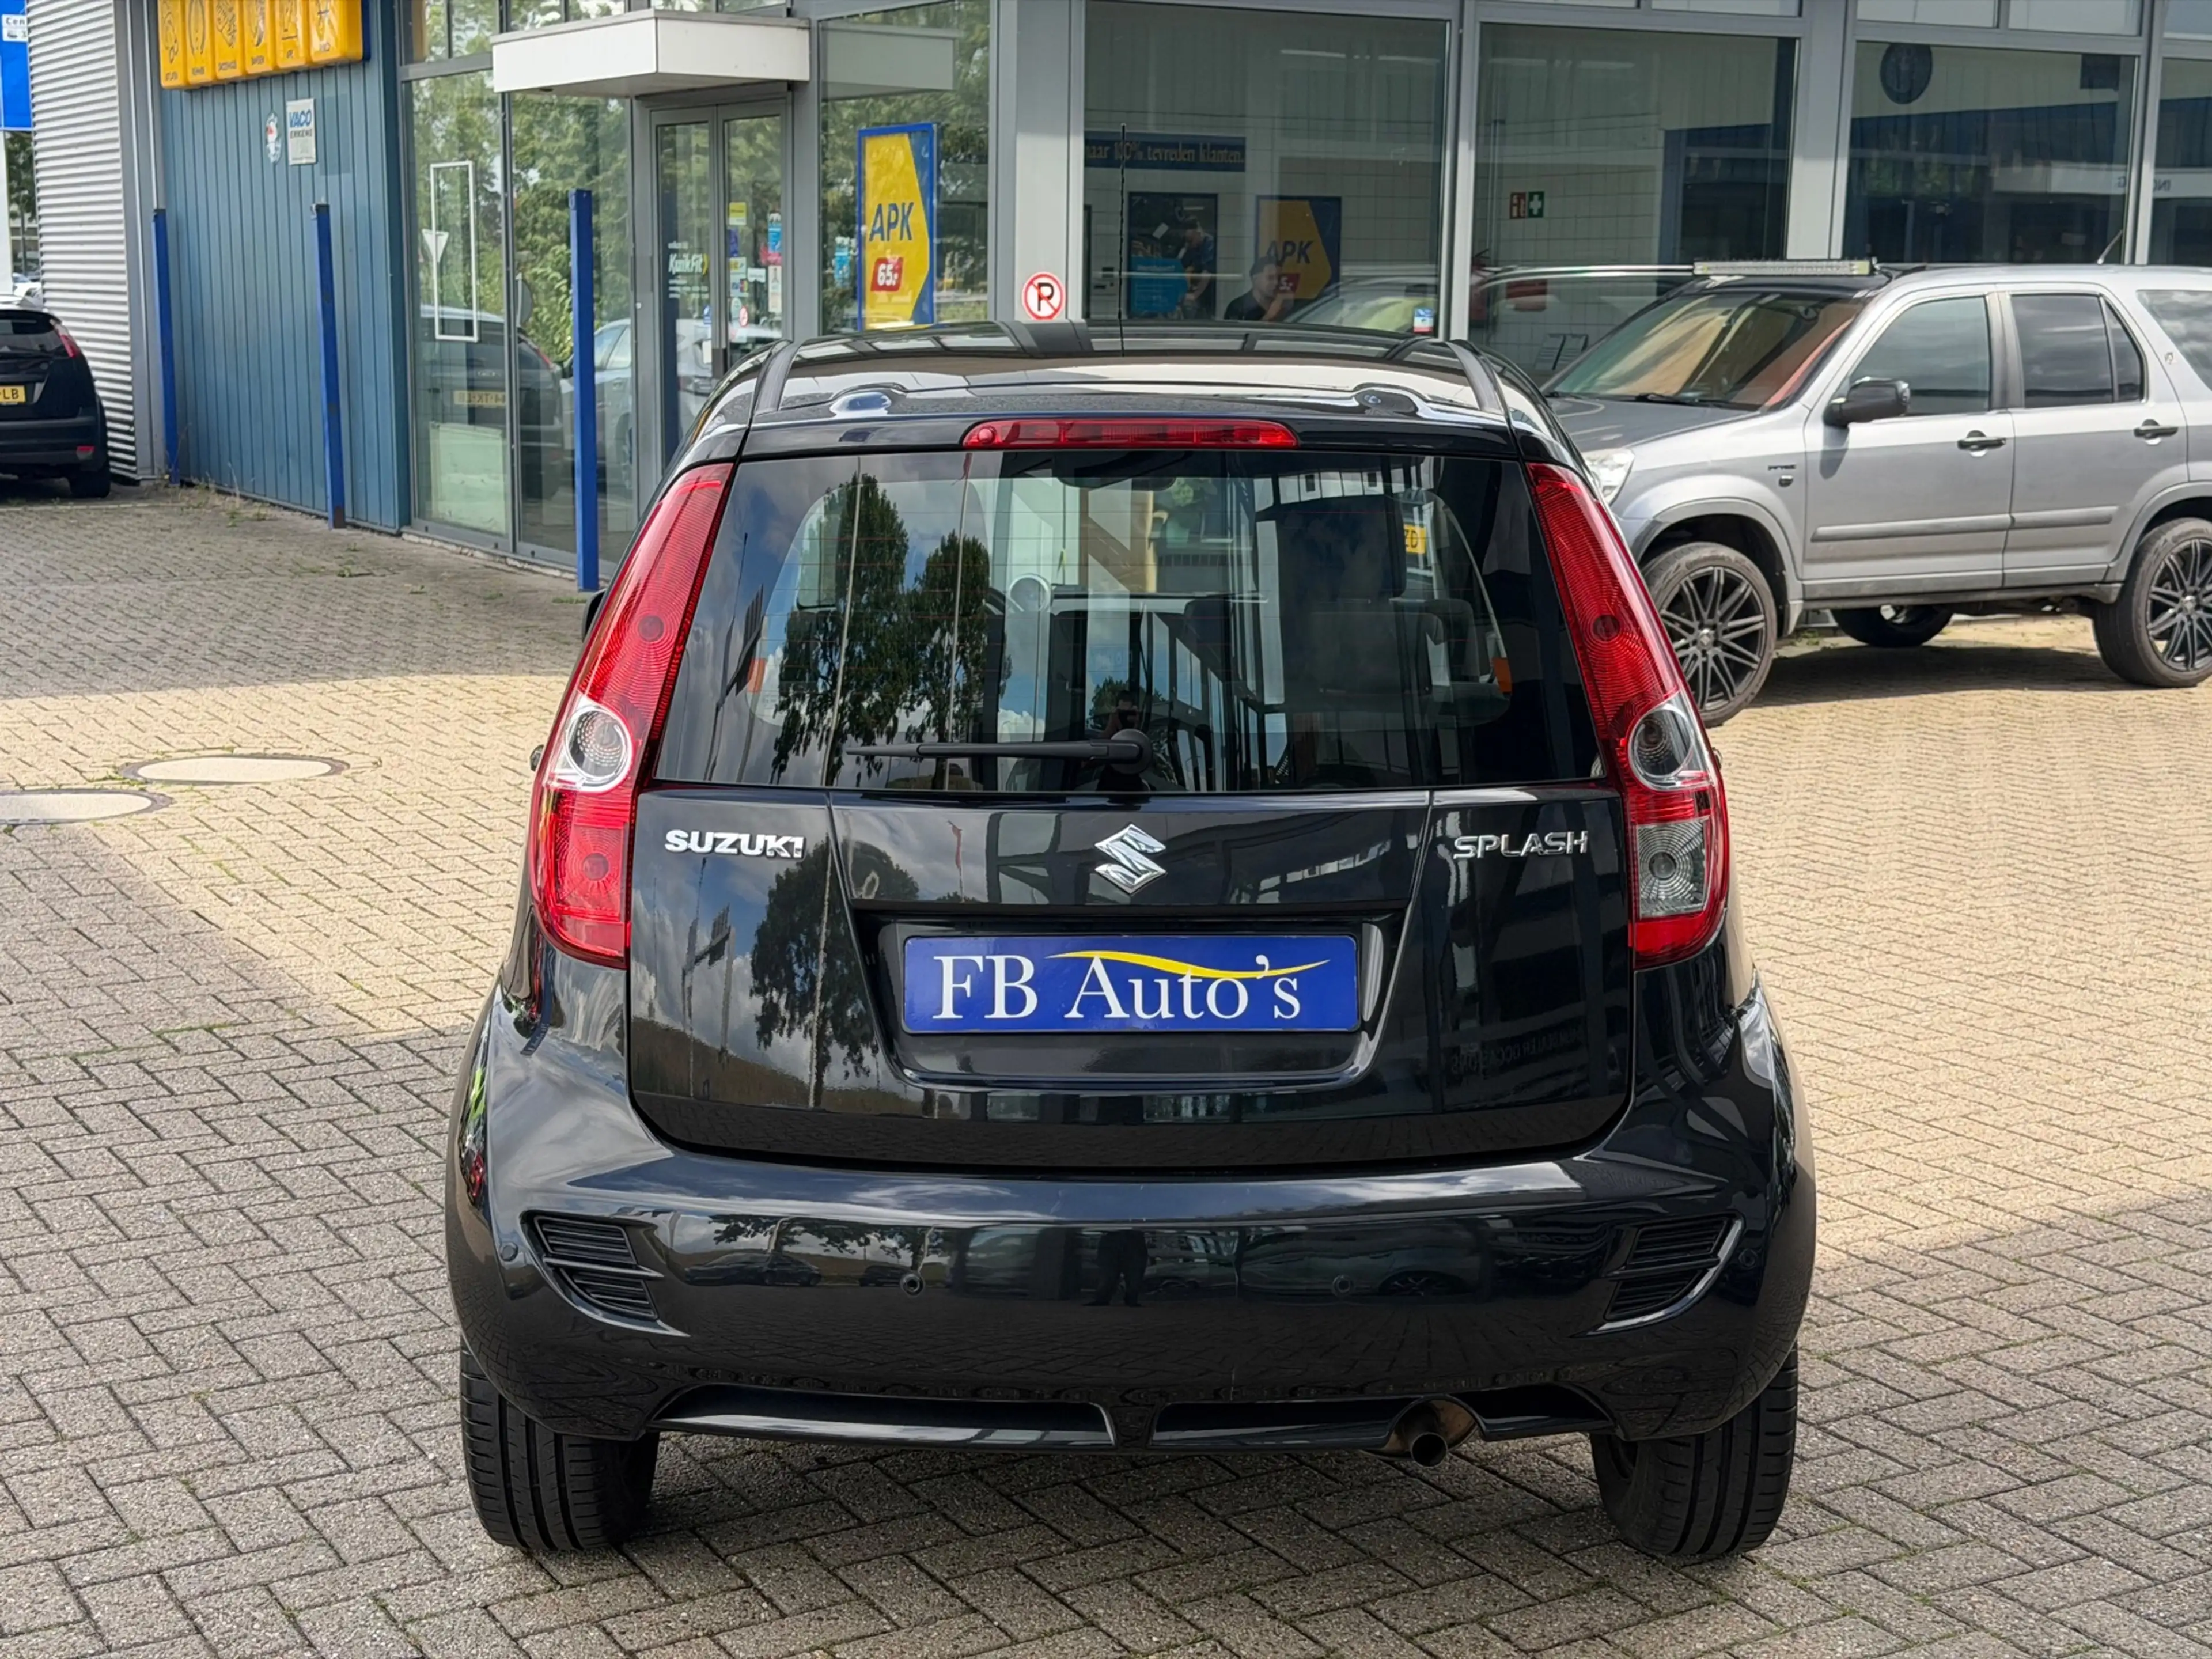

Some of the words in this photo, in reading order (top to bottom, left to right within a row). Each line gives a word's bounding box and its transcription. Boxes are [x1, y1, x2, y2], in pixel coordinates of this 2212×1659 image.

[289, 109, 312, 127] VACO
[1147, 141, 1195, 162] tevreden
[869, 202, 914, 242] APK
[1266, 240, 1313, 266] APK
[664, 829, 805, 859] SUZUKI
[1453, 830, 1589, 860] SPLASH
[931, 954, 1038, 1020] FB
[1063, 953, 1301, 1020] Auto's
